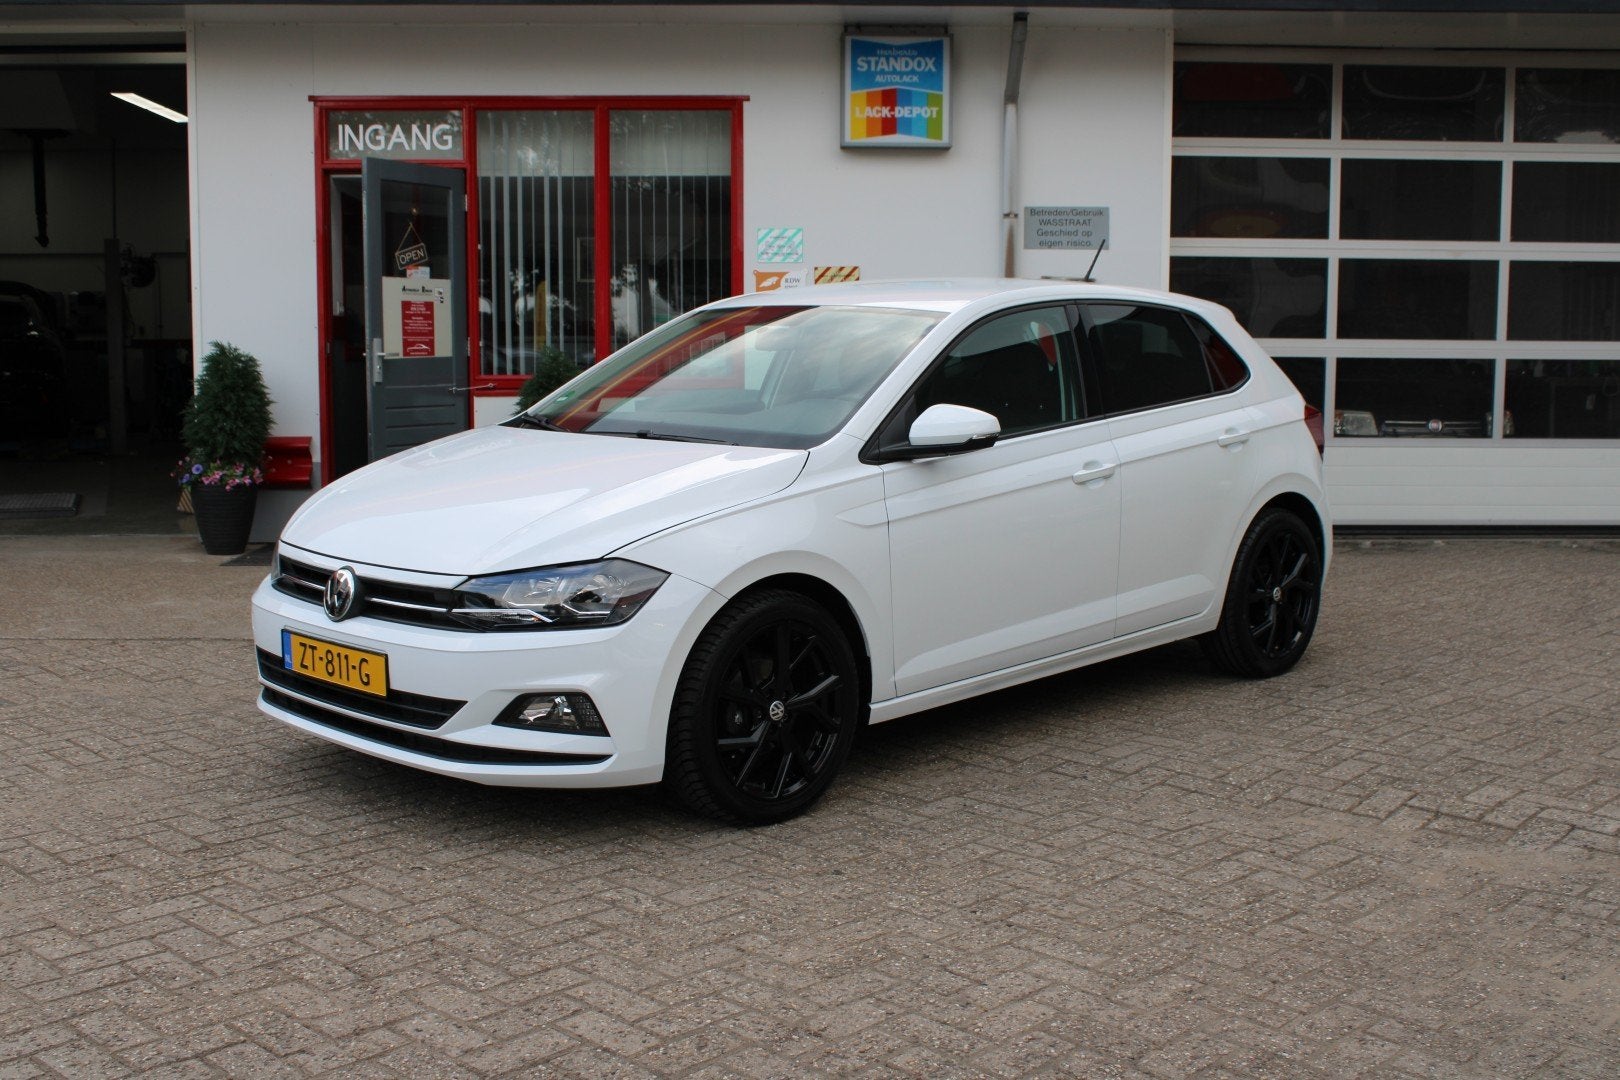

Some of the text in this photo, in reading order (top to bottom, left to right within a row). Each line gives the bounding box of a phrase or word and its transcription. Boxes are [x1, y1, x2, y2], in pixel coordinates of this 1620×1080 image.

[856, 57, 936, 72] STANDOX
[875, 74, 919, 83] AUTOLACK
[855, 106, 939, 118] LACK-DEPOT
[338, 124, 453, 151] INGANG
[1038, 219, 1091, 227] WASSTRAAT
[1036, 229, 1093, 238] Geschied op
[1039, 240, 1063, 249] eigen
[399, 248, 425, 265] OPEN
[299, 641, 371, 686] ZT-811-G
